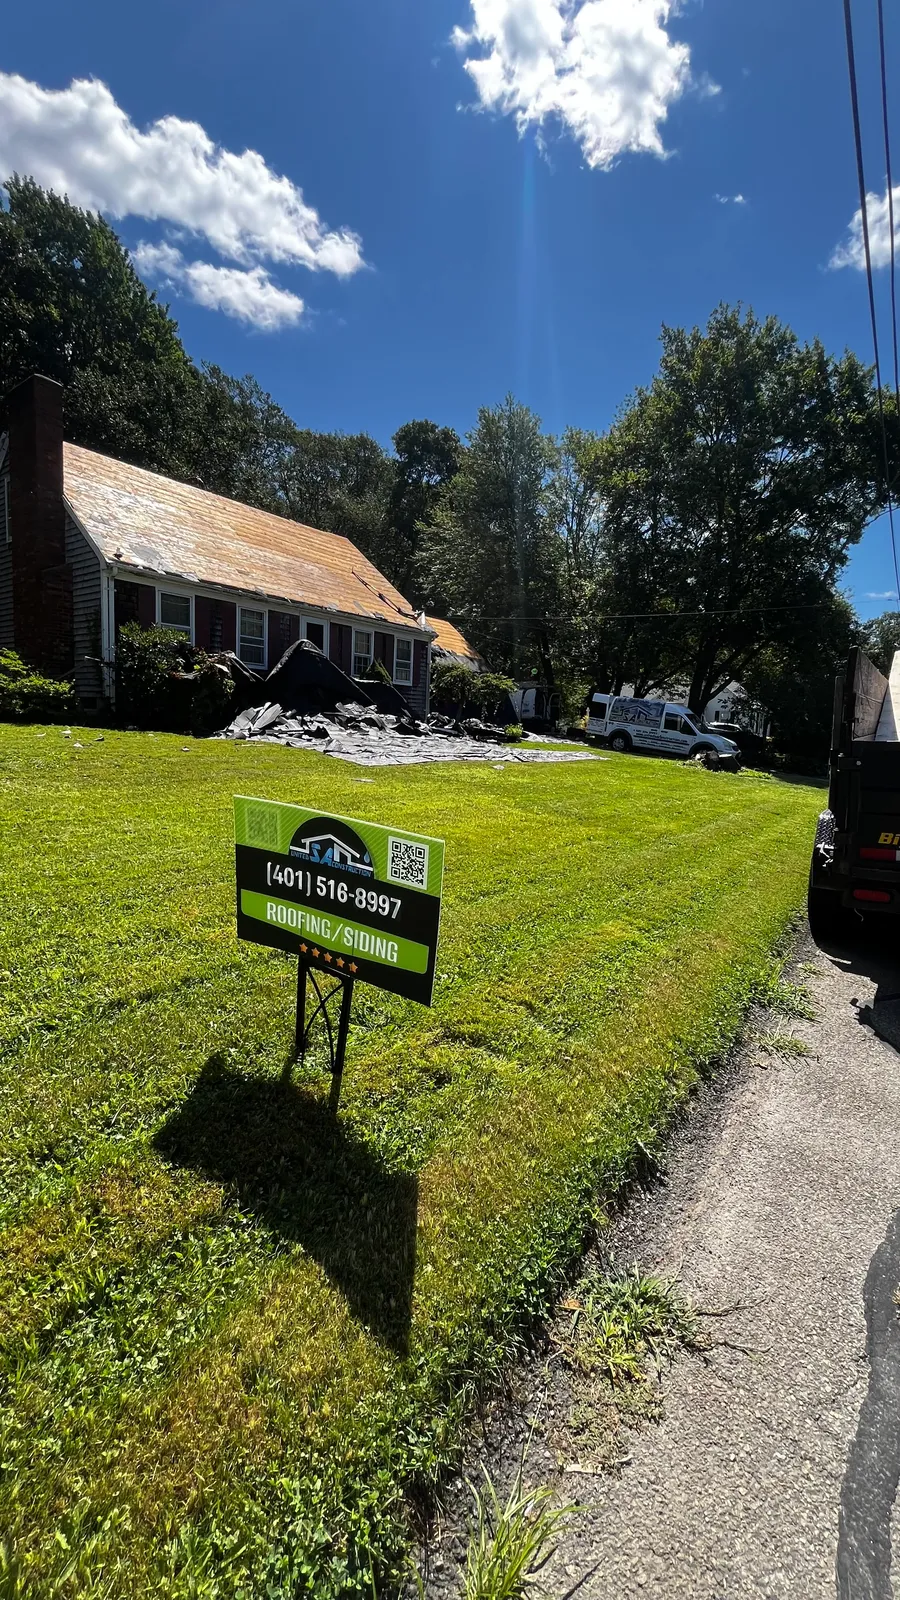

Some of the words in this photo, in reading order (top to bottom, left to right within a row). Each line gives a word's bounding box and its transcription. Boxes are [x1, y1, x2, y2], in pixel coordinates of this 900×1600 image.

[266, 861, 311, 897] (401)
[316, 875, 401, 919] 516-8997
[290, 851, 310, 860] UNITED
[331, 861, 372, 877] CONSTRUCTION
[266, 901, 399, 963] ROOFING/SIDING
